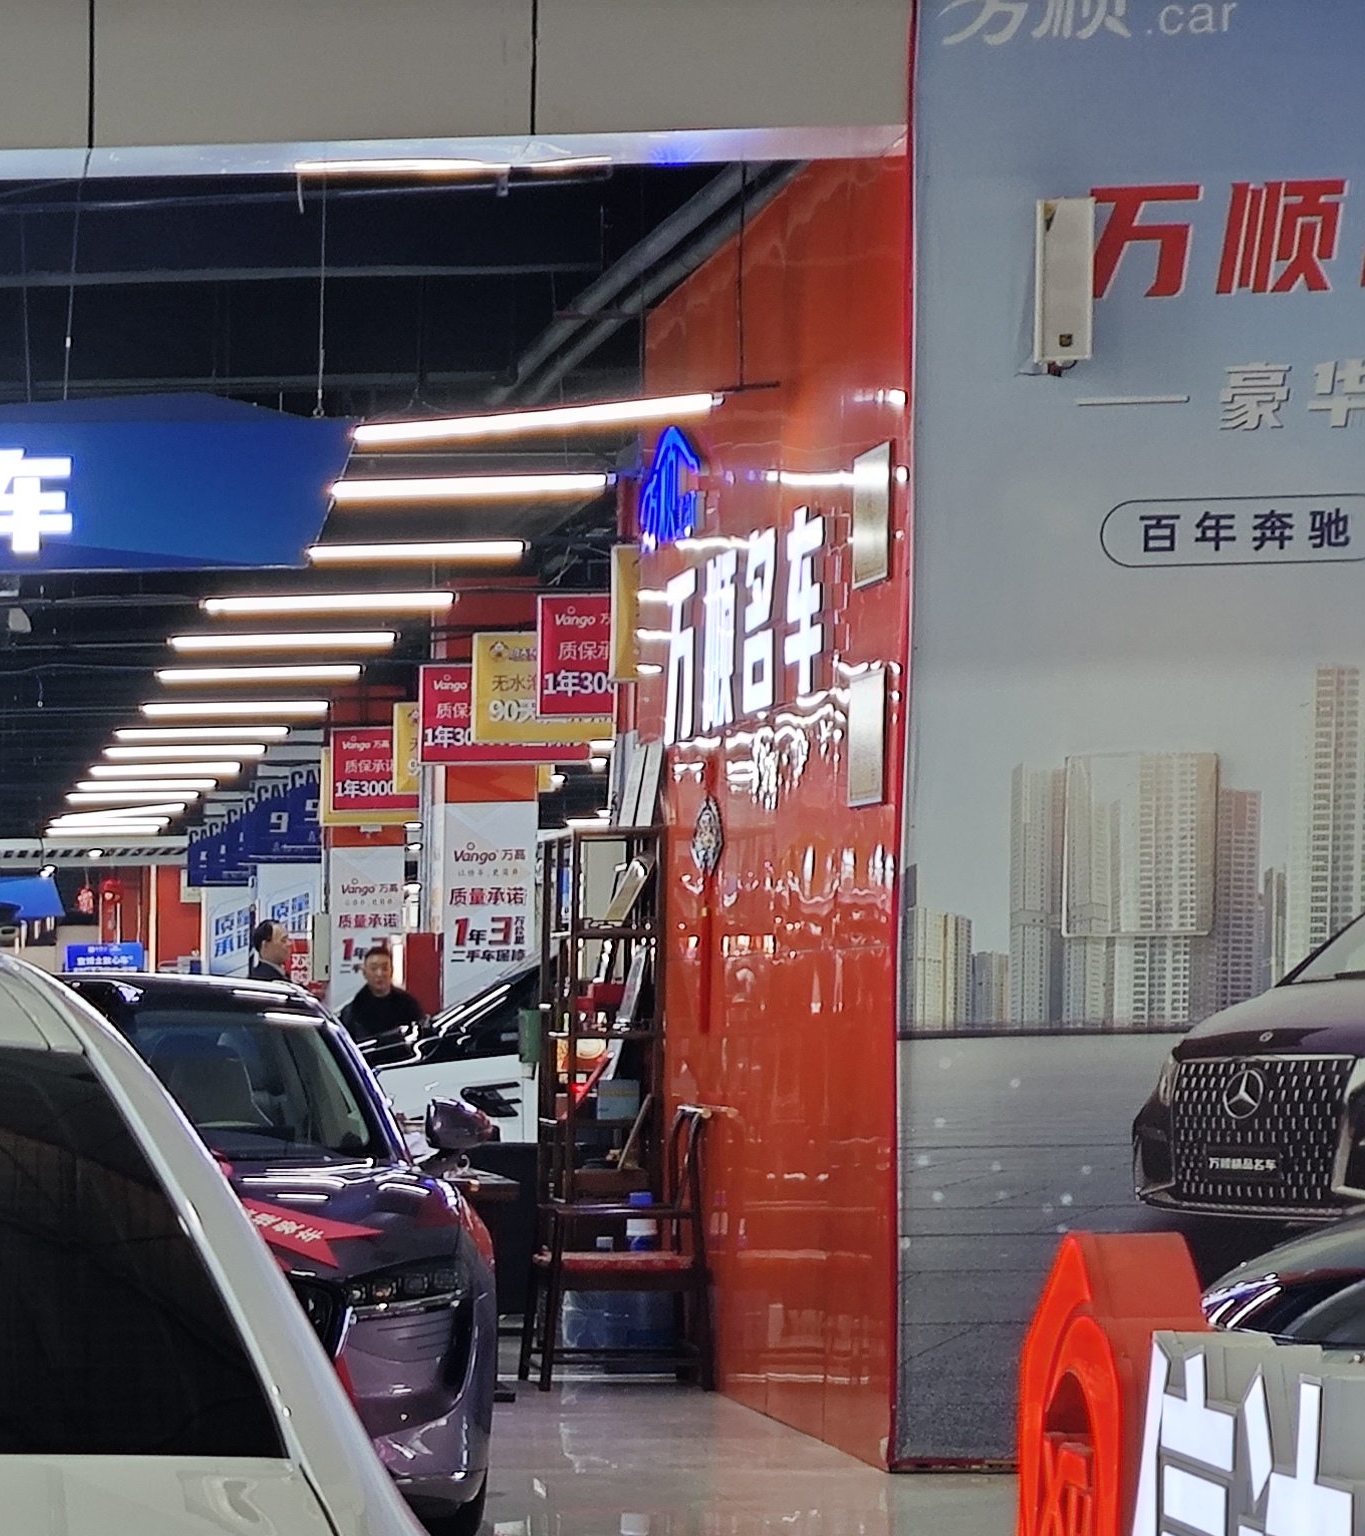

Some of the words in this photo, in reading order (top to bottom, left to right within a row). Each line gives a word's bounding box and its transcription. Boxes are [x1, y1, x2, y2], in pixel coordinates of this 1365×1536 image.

[1089, 178, 1365, 299] 万顺
[1218, 359, 1365, 431] 豪华
[1138, 507, 1352, 553] 百年奔驰
[554, 613, 596, 629] Vango
[664, 505, 825, 747] 万顺名车
[433, 679, 468, 693] Vango
[436, 702, 472, 720] 质保
[453, 849, 497, 865] Vango
[341, 883, 376, 897] Vango
[449, 886, 527, 907] 质量承诺
[338, 913, 398, 929] 质量承诺
